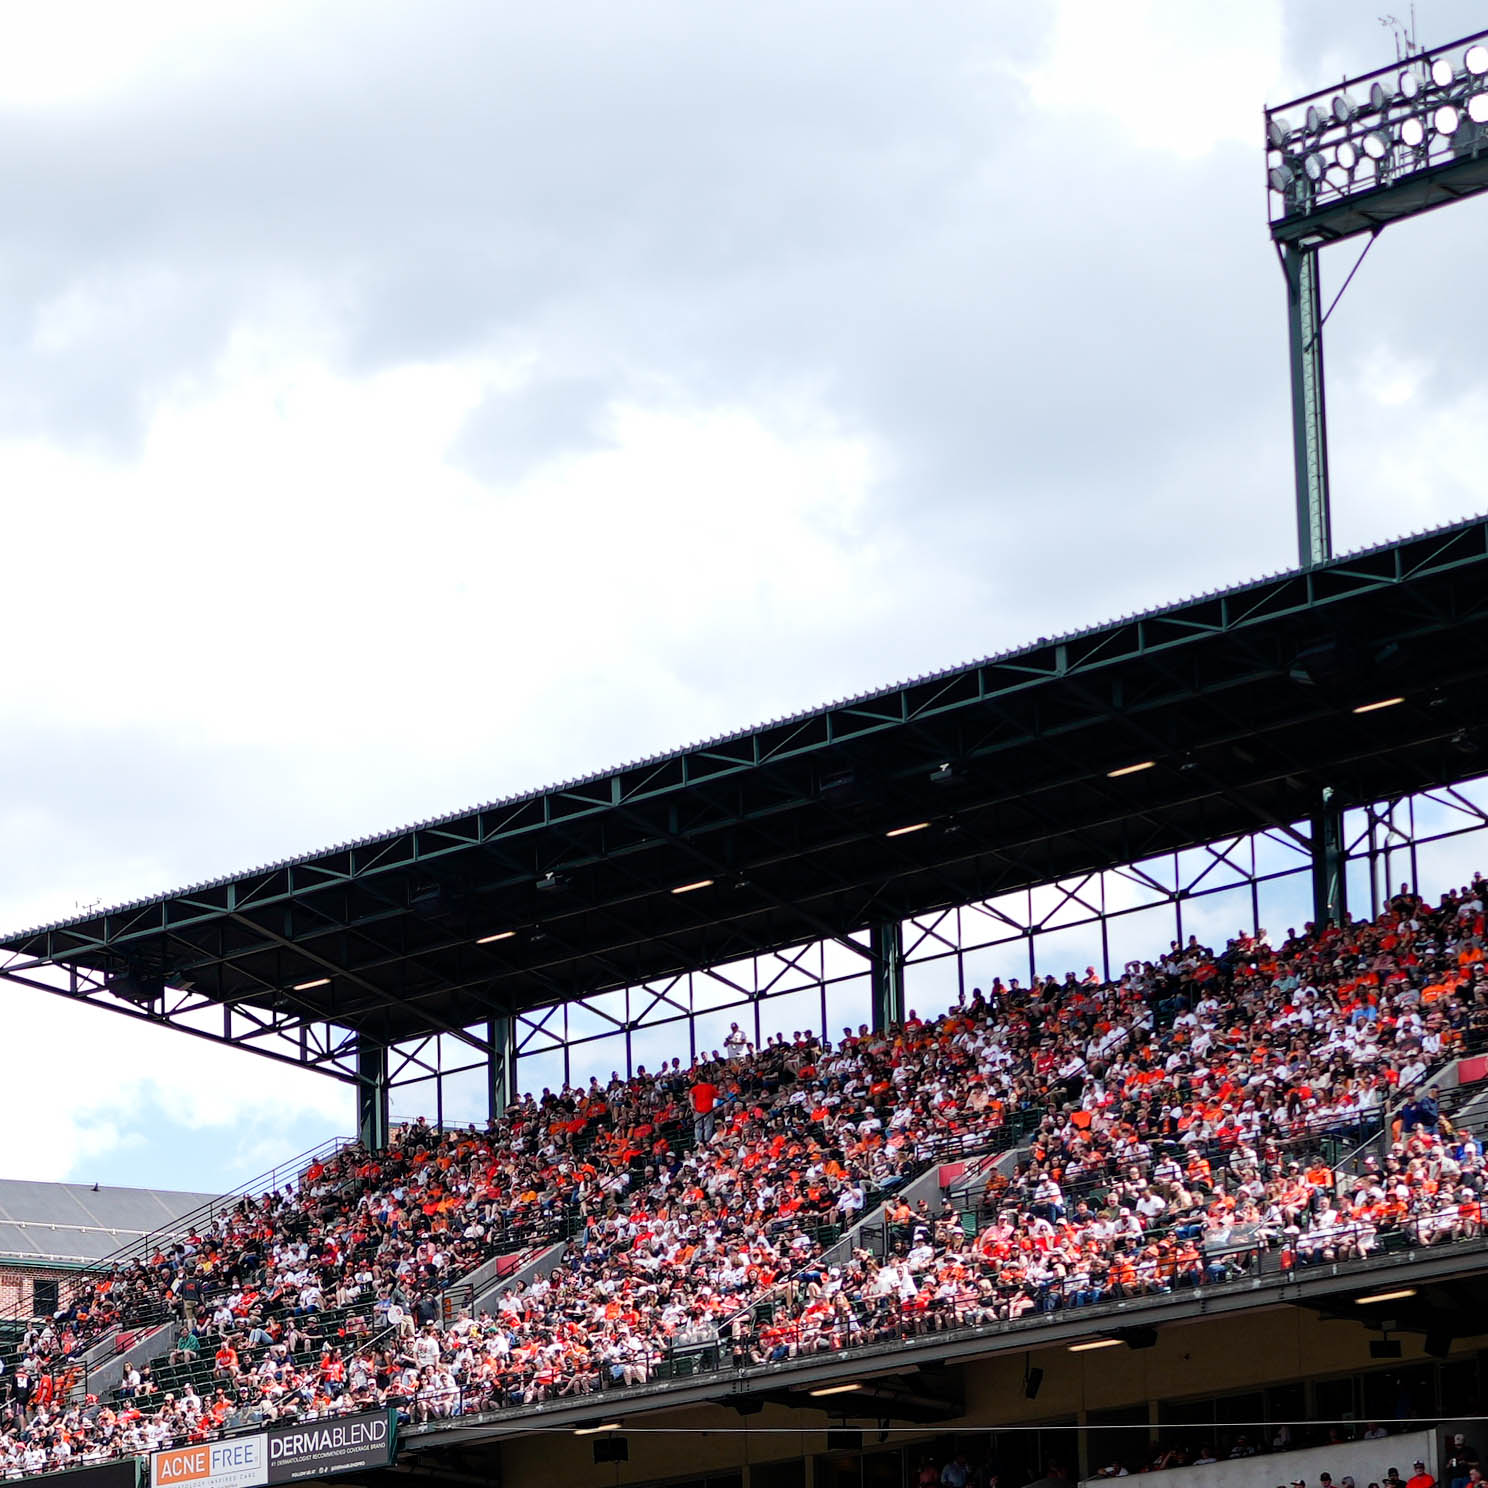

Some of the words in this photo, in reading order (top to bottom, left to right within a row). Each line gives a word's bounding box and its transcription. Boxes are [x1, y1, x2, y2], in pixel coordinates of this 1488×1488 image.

[270, 1420, 386, 1459] DERMABLEND
[160, 1453, 206, 1480] ACNE
[212, 1444, 254, 1470] FREE
